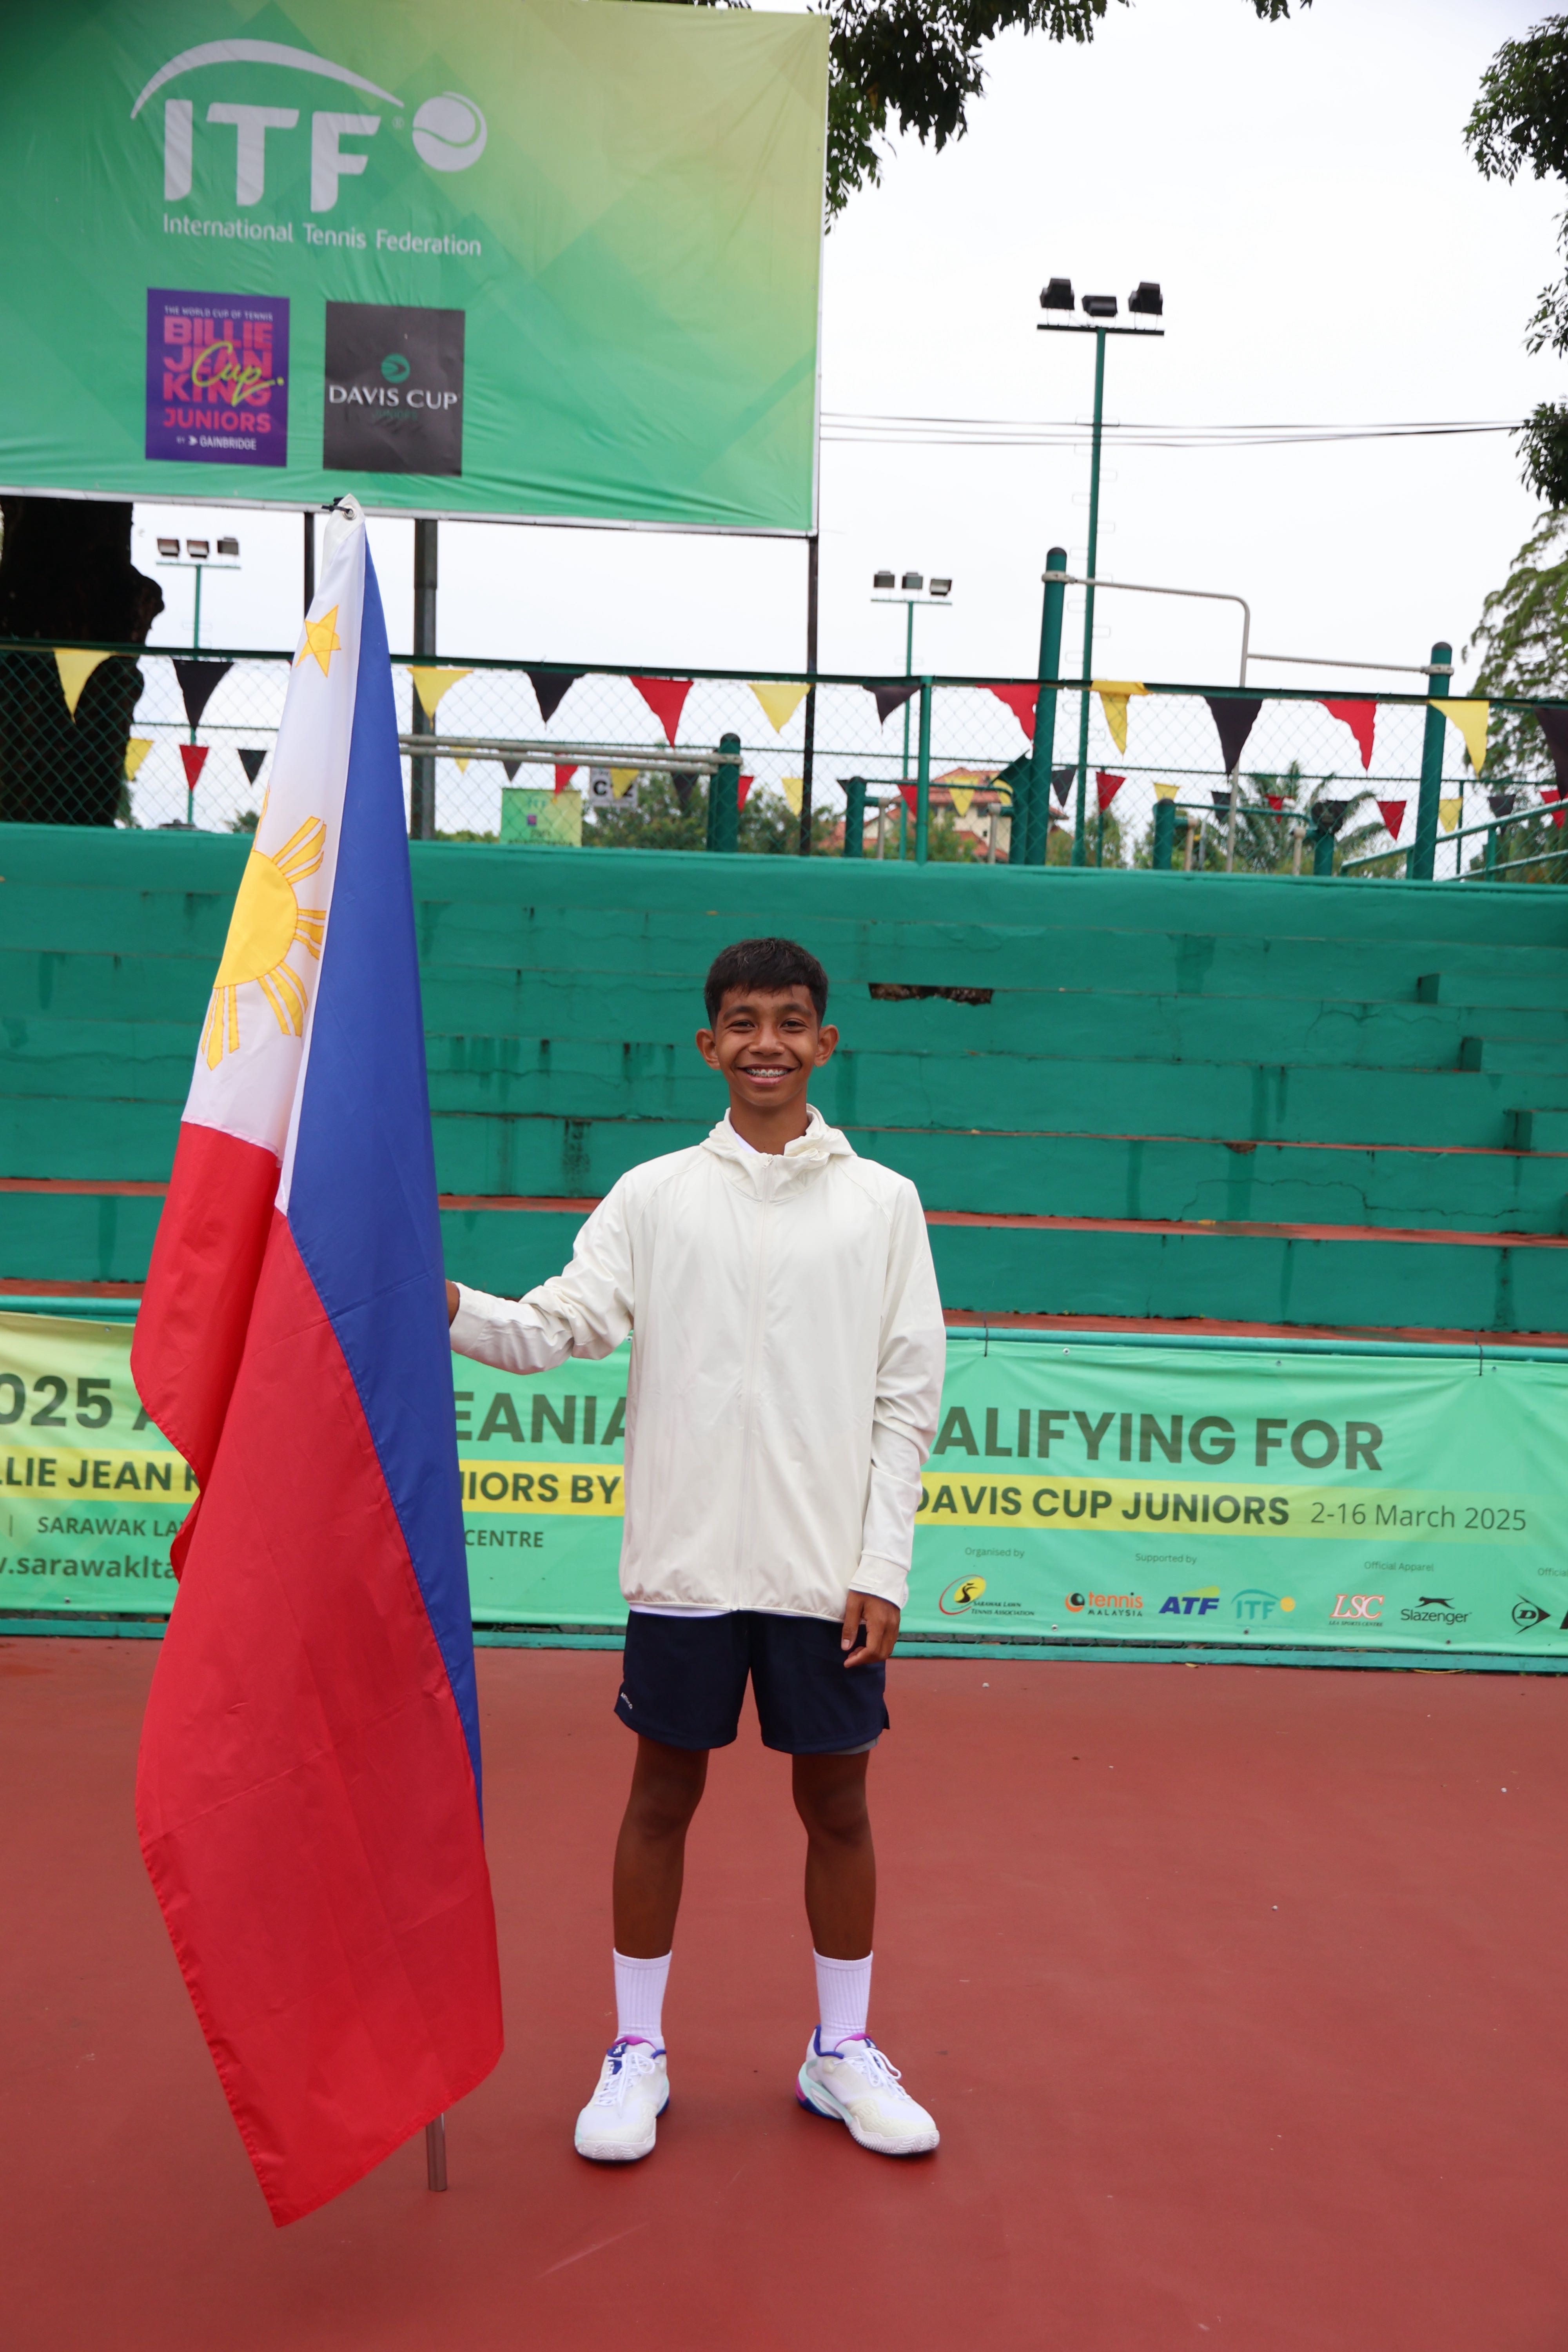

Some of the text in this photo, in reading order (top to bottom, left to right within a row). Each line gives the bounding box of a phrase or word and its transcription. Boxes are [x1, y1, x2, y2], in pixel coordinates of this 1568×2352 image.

[164, 98, 381, 212] ITF
[163, 213, 481, 256] International Tennis Federation
[165, 305, 273, 322] THE WORLD CUP OF TENNIS
[164, 315, 272, 350] BILLIE
[163, 345, 272, 378] JEAN
[163, 372, 271, 407] KING
[329, 384, 457, 410] DAVIS CUP
[163, 408, 271, 433] JUNIORS
[200, 435, 257, 450] GAINBRIDGE
[933, 1406, 1236, 1465] ALIFYING
[1256, 1418, 1383, 1471] FOR
[0, 1457, 56, 1487] LIE
[68, 1459, 172, 1491] JEAN
[459, 1471, 559, 1503] IORS
[571, 1474, 621, 1504] BY
[1033, 1488, 1112, 1518] CUP
[1122, 1492, 1289, 1525] JUNIORS
[1310, 1502, 1366, 1524] 2-16
[1375, 1504, 1455, 1528] March
[1465, 1507, 1526, 1530] 2025
[37, 1516, 544, 1548] SARAWAK LA CENTRE
[965, 1547, 1025, 1558] Organised by
[1136, 1553, 1197, 1564] Supported by
[1364, 1561, 1434, 1572] Official Apparel
[1089, 1591, 1143, 1609] tennis
[1158, 1596, 1220, 1615] ATF
[1237, 1600, 1276, 1620] ITF
[1329, 1593, 1385, 1620] LSC
[1400, 1608, 1469, 1625] Slazenger
